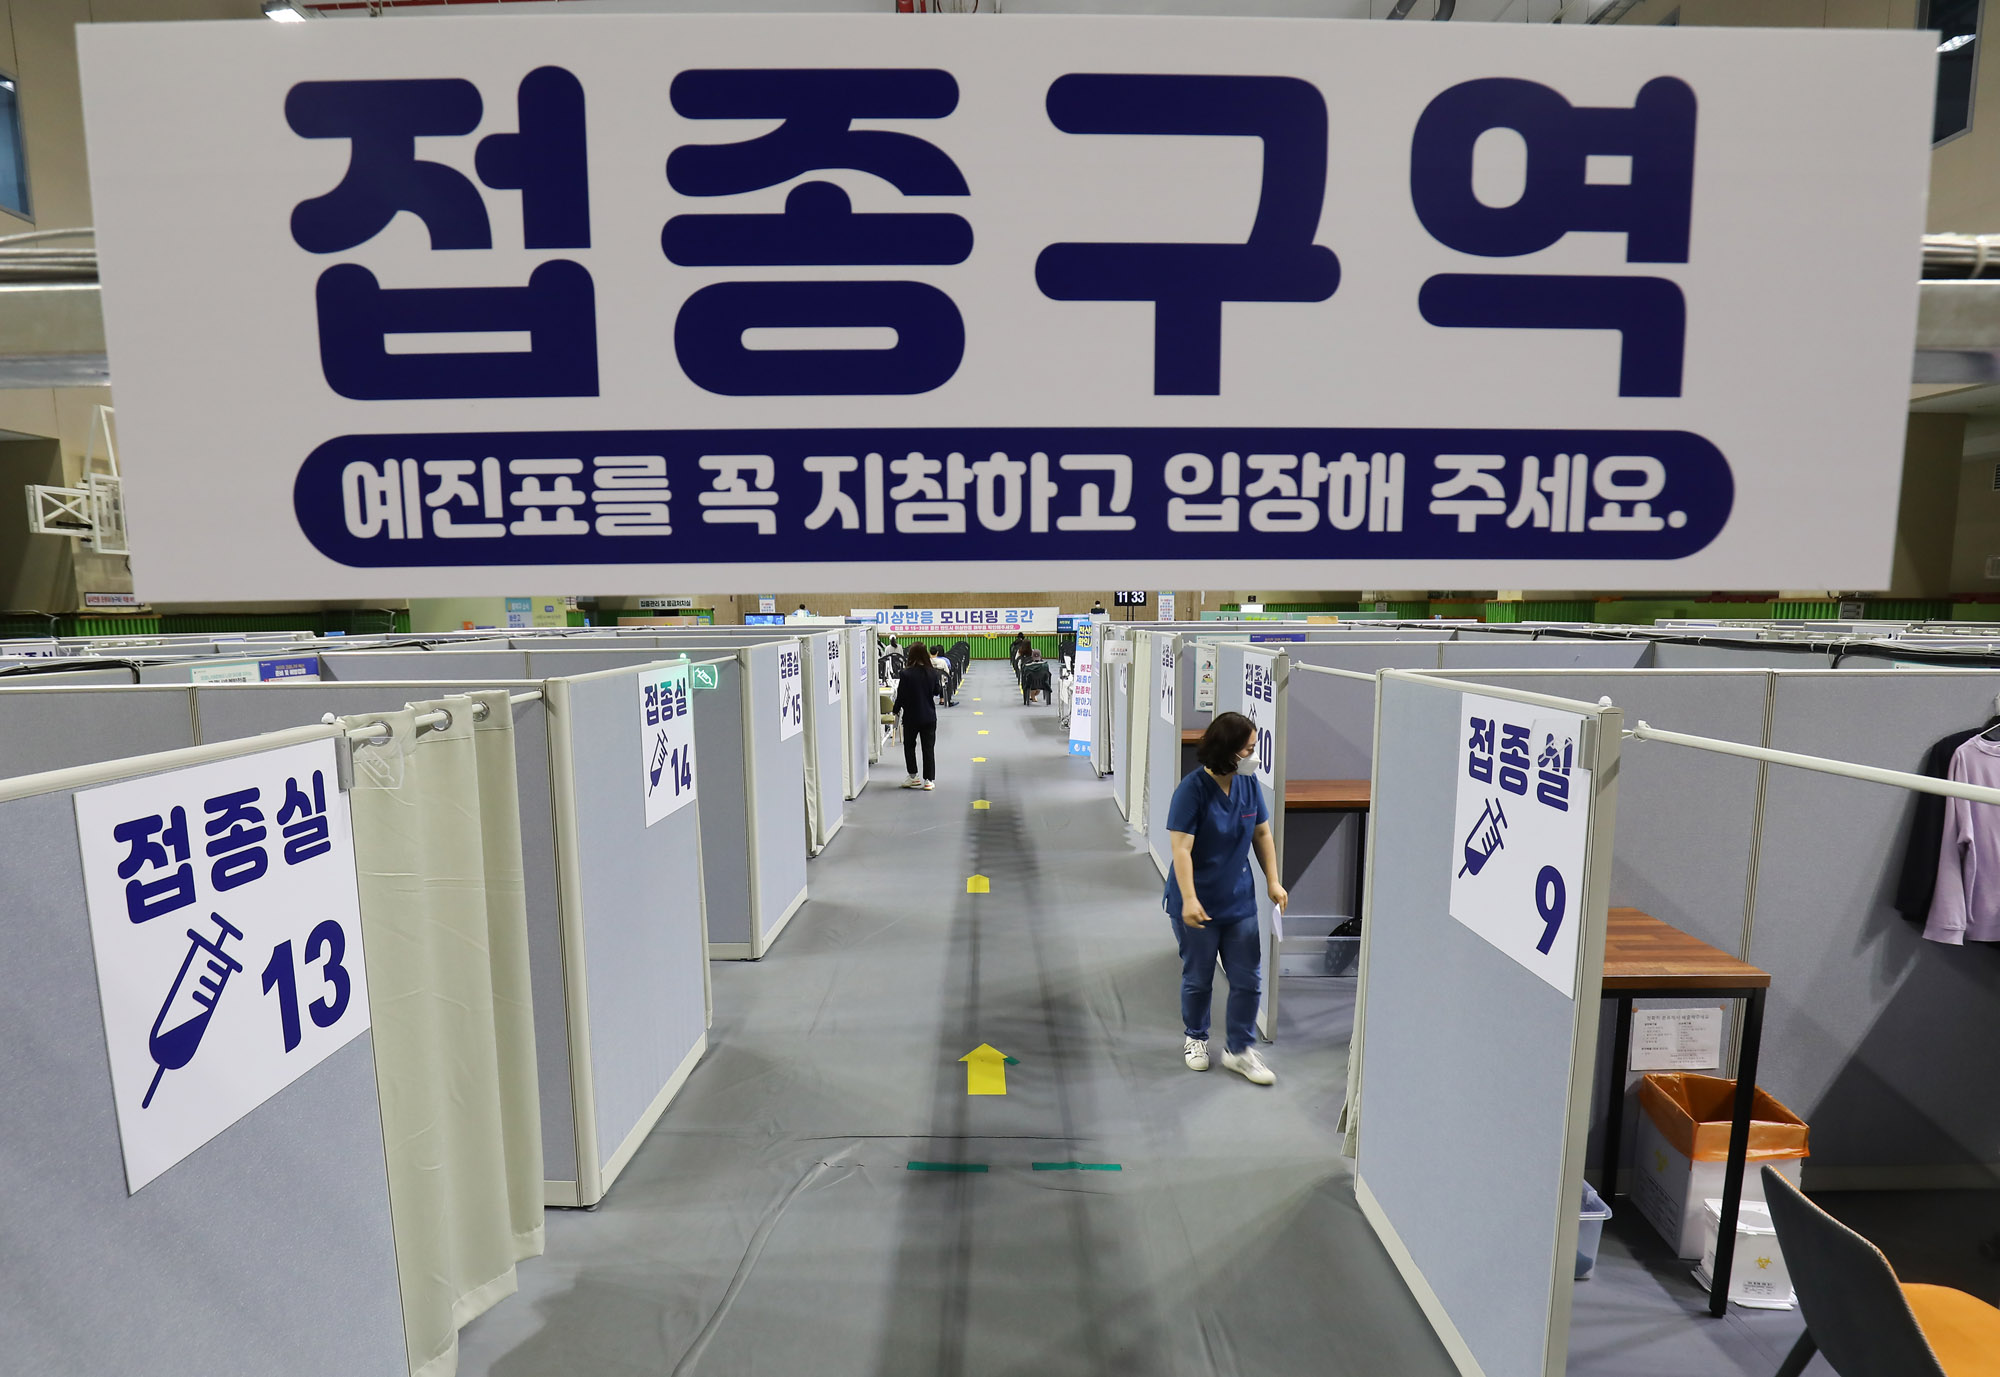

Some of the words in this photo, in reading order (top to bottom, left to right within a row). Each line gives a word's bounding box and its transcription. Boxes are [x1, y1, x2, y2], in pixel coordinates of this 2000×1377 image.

[285, 65, 1698, 398] 접종구역
[341, 456, 673, 540] 예진표를
[698, 454, 779, 535] 꼭
[804, 451, 1137, 534] 지참하고
[1165, 451, 1406, 533] 입장해
[1430, 451, 1687, 533] 주세요.
[876, 610, 934, 624] 이상반응
[940, 610, 998, 624] 모니터링
[1005, 610, 1034, 624] 공간
[1117, 591, 1128, 603] 11
[1131, 591, 1145, 603] 33
[780, 651, 799, 679] 접종실
[1246, 663, 1272, 704] 접종실
[644, 677, 687, 727] 접종실
[791, 693, 801, 726] 15
[671, 743, 691, 796] 14
[1257, 726, 1272, 775] 10
[1469, 717, 1573, 812] 접종실
[113, 769, 332, 924] 접종실
[1535, 864, 1567, 956] 9
[261, 919, 352, 1054] 13
